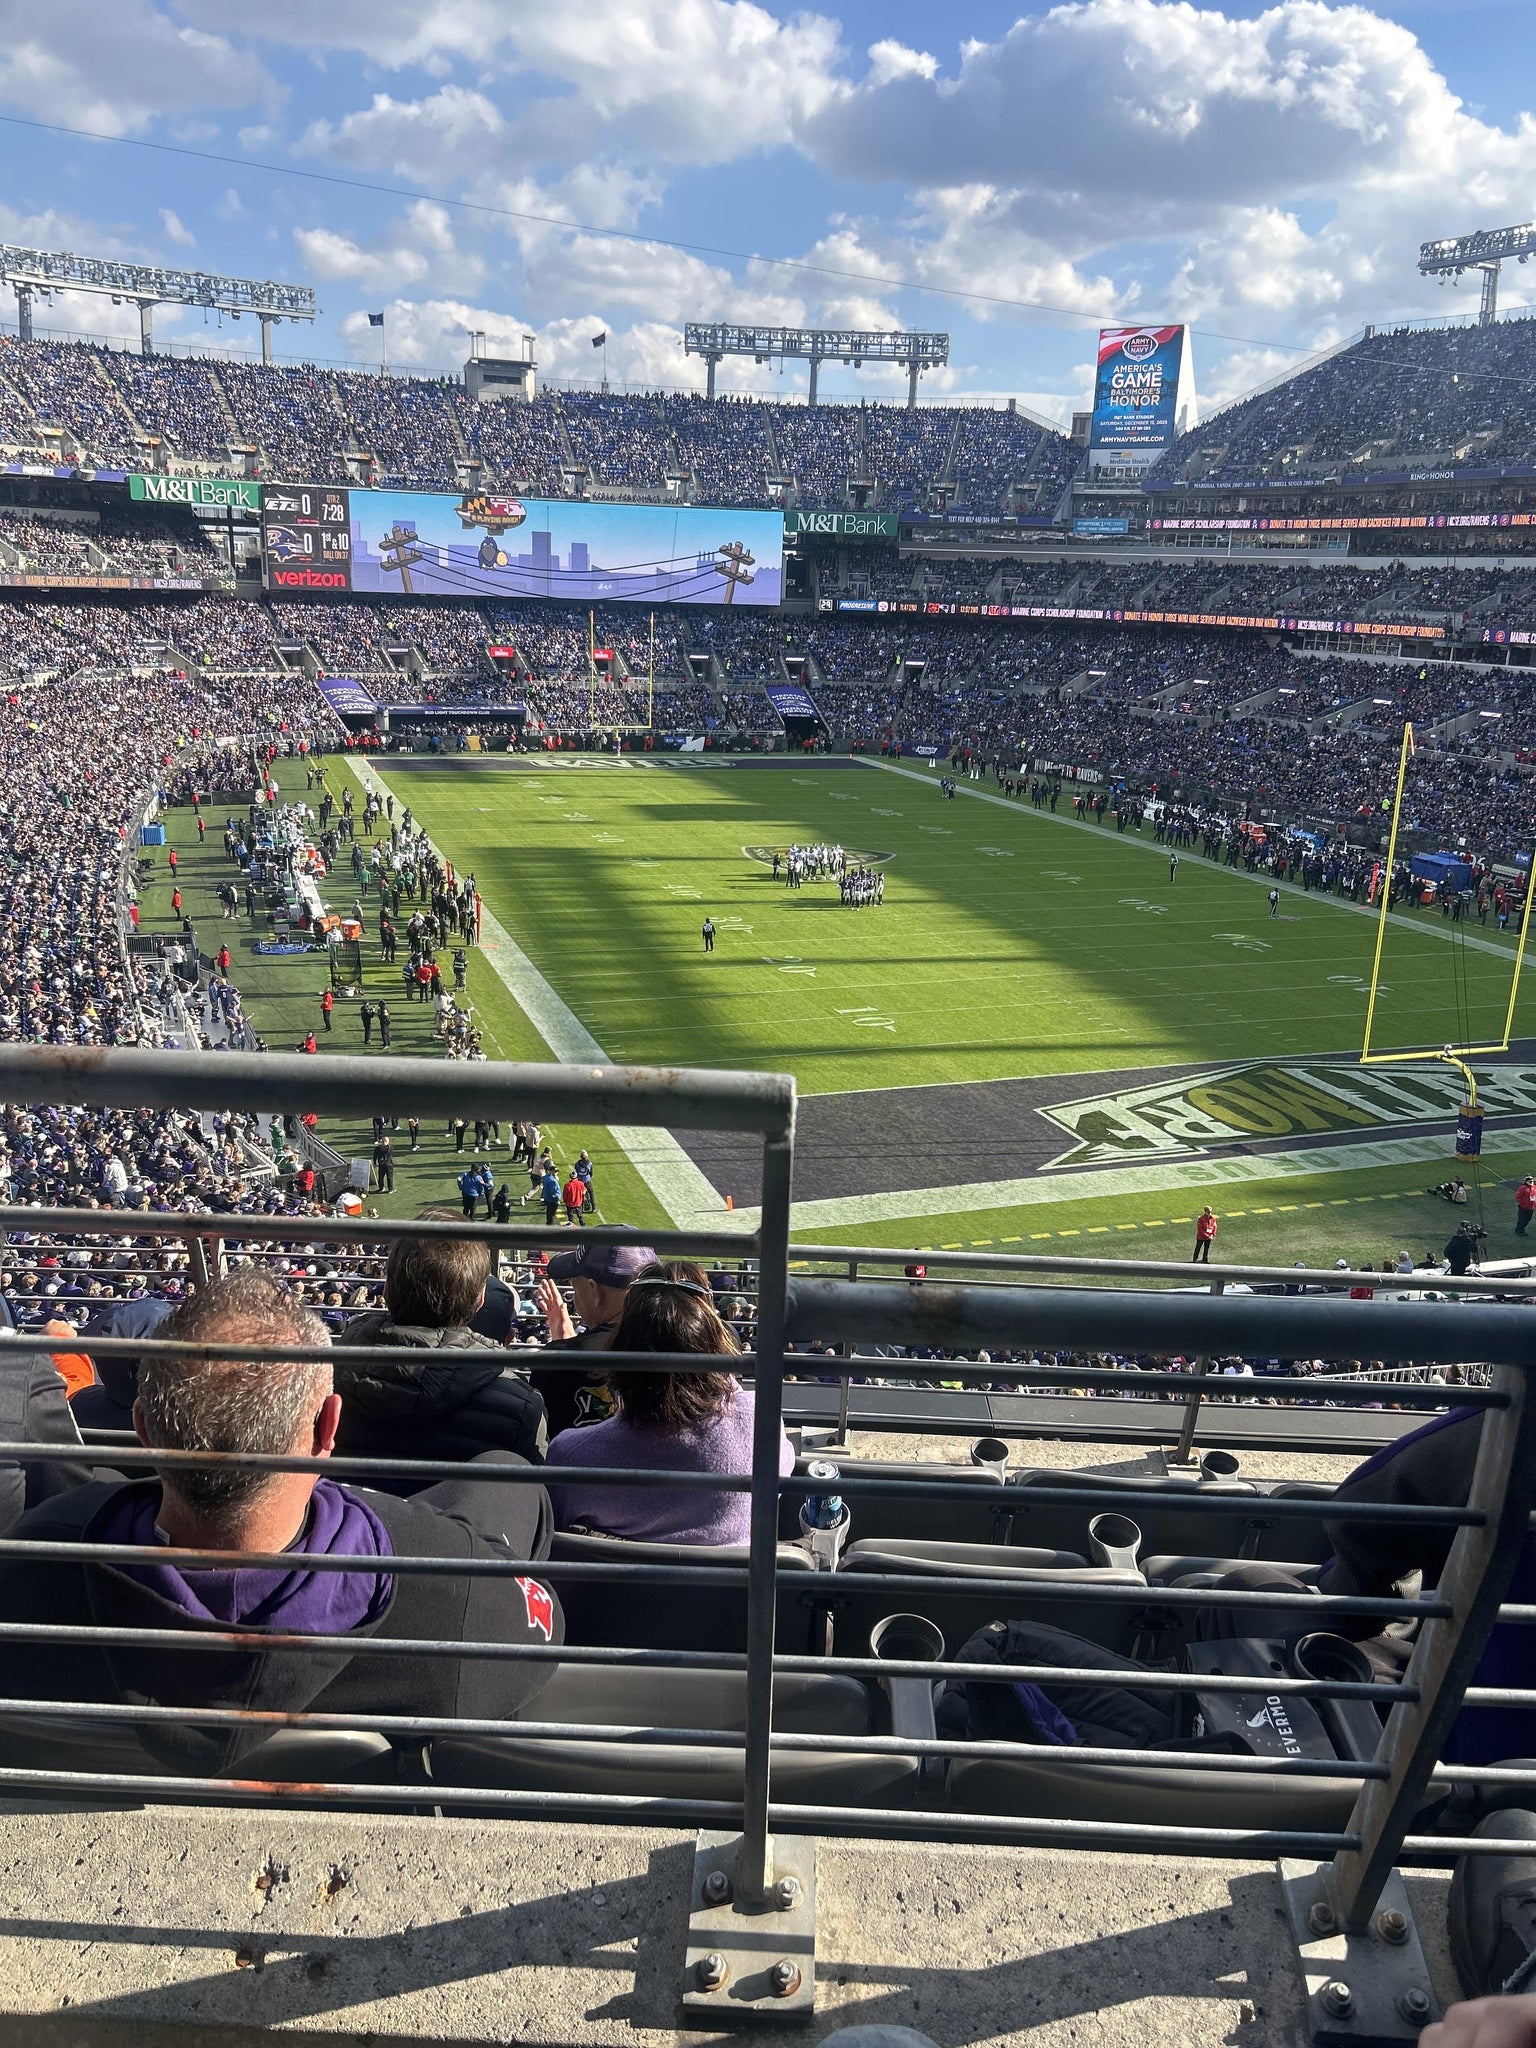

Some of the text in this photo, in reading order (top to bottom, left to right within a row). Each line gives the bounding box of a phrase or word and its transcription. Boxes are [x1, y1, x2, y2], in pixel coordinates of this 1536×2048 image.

[1113, 363, 1163, 374] AMERICA'S
[1111, 372, 1162, 388] GAME
[1110, 388, 1161, 396] BALTIMORE'S
[1109, 395, 1160, 407] HONOR
[1410, 472, 1426, 481] RING
[1430, 471, 1455, 480] HONOR
[142, 477, 251, 506] M&T Bank
[301, 494, 311, 515] 0
[322, 504, 344, 521] 7:28
[796, 512, 887, 534] M&T Bank
[303, 533, 313, 554] 0
[63, 576, 98, 588] SCHOLARSHIP
[274, 568, 346, 587] verizon
[1011, 606, 1030, 616] MARINE
[1045, 607, 1076, 618] SCHOLARSHIP
[1354, 623, 1371, 634] MARINE
[1386, 624, 1417, 636] SCHOLARSHIP
[1510, 631, 1530, 643] MARINE
[1077, 767, 1099, 784] RAVENS
[760, 955, 817, 973] 20
[834, 1005, 896, 1028] 10
[1177, 1157, 1256, 1183] US
[1266, 1695, 1302, 1755] EVERMO
